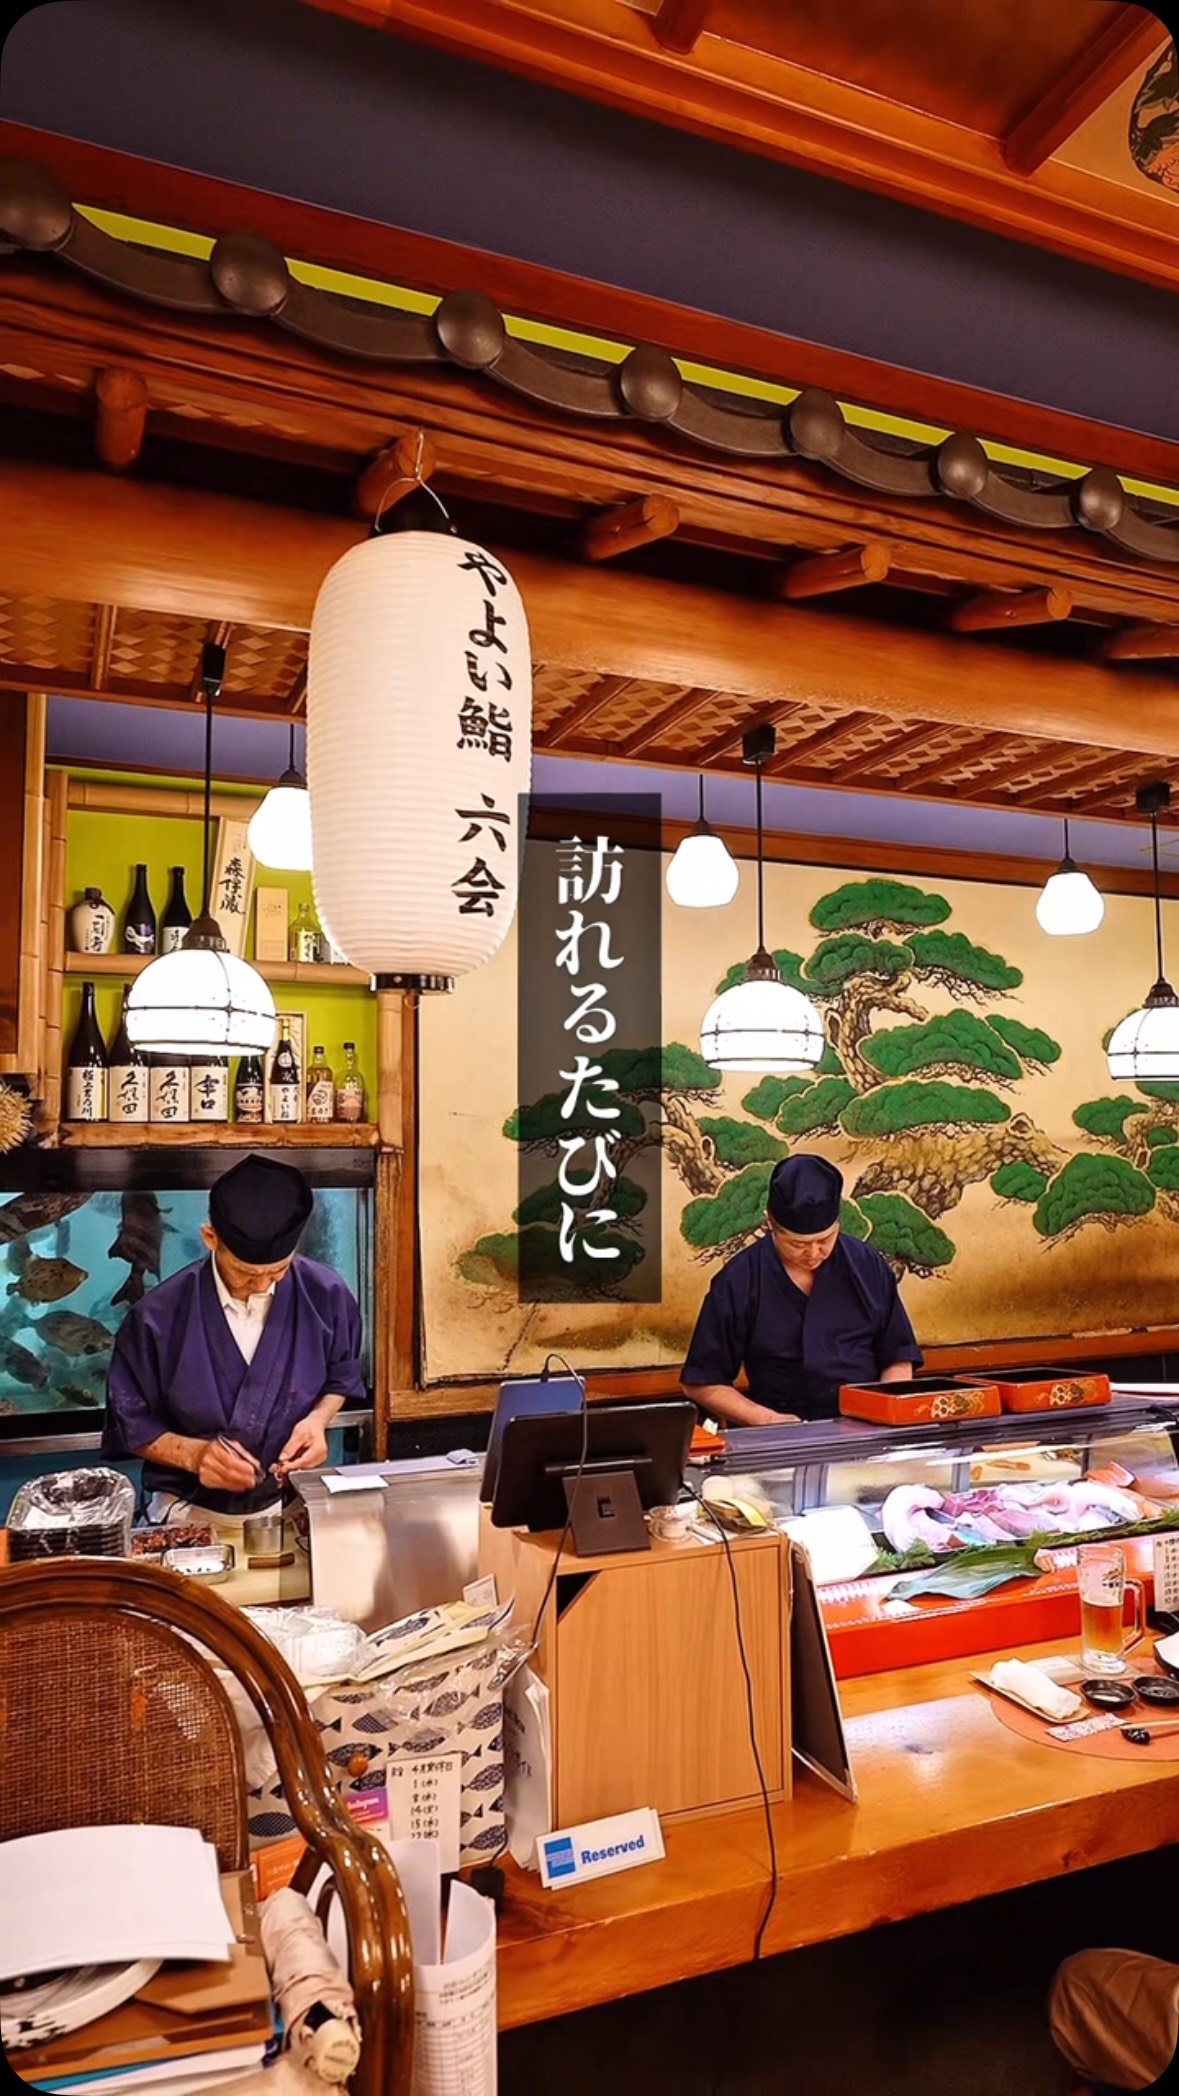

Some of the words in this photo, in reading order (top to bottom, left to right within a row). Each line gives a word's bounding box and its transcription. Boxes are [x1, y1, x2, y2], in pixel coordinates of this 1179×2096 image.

[457, 551, 512, 762] やよい鮨
[451, 793, 511, 918] 六会
[581, 1835, 646, 1864] Reserved
